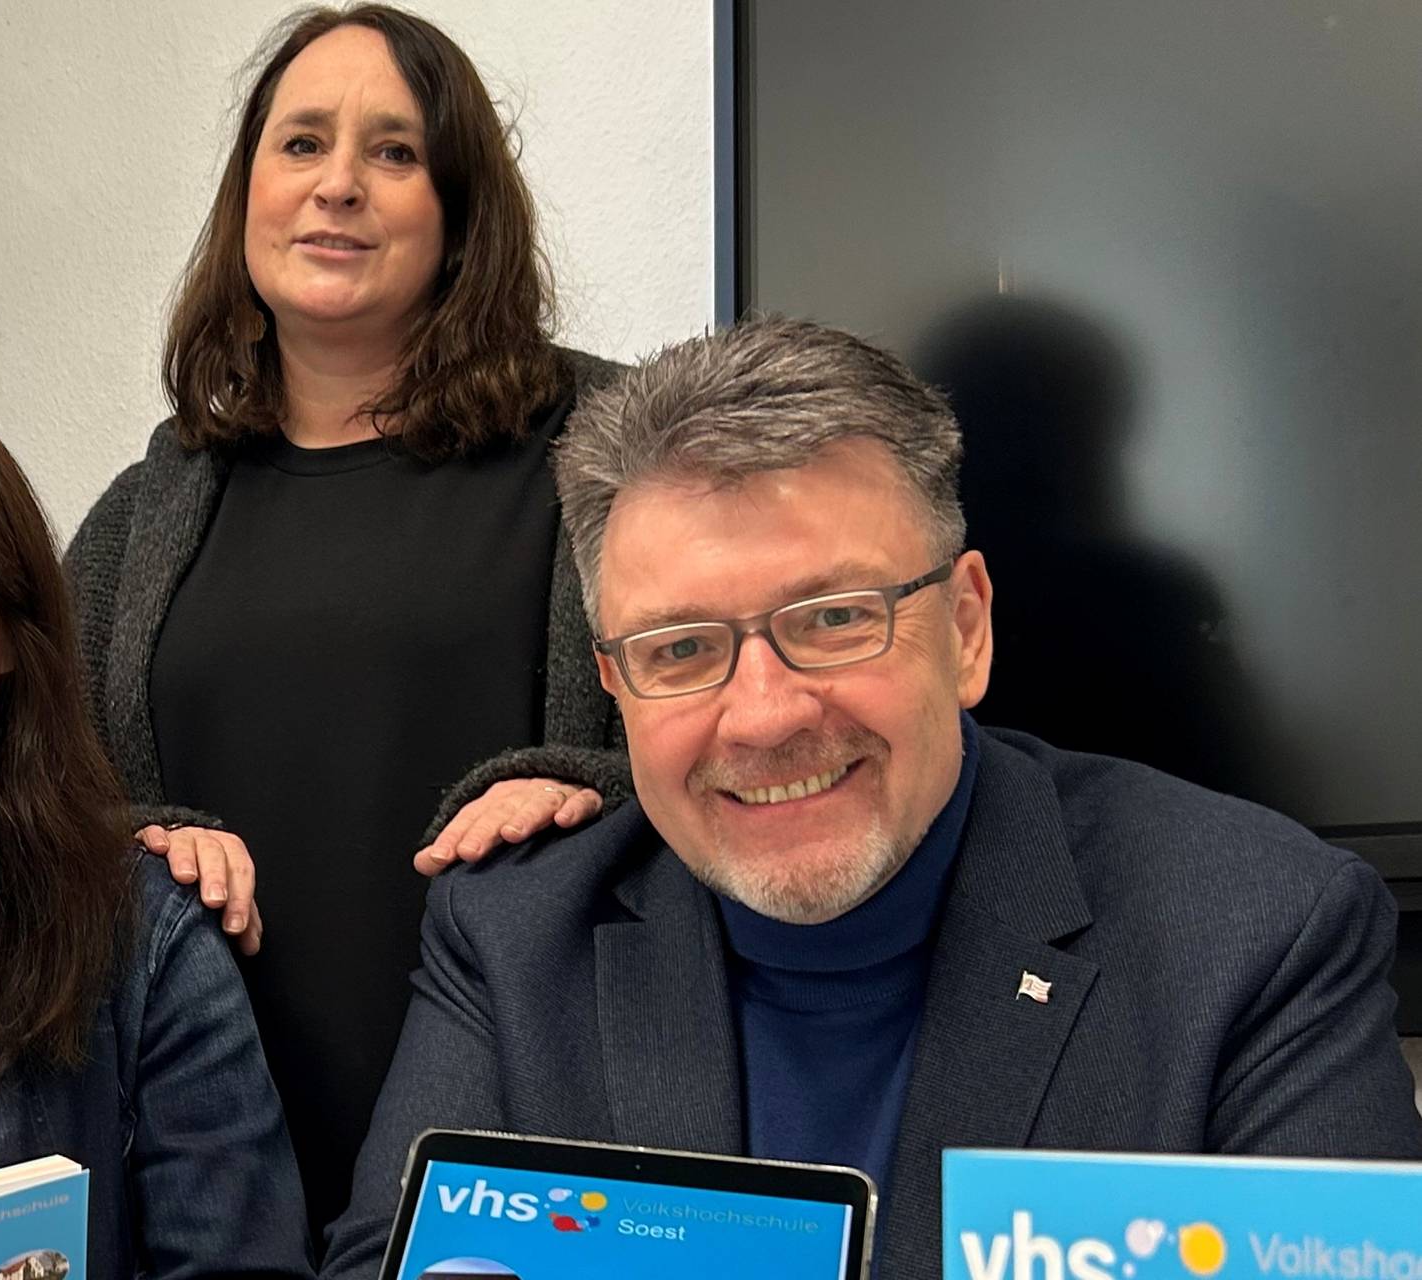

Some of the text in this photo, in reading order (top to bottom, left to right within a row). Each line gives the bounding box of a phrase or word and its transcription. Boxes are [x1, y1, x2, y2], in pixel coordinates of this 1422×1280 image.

[437, 1178, 539, 1222] vhs
[622, 1196, 819, 1233] Volkshochschule
[617, 1218, 686, 1241] Soest
[959, 1209, 1116, 1280] vhs
[1247, 1231, 1422, 1280] Volksho
